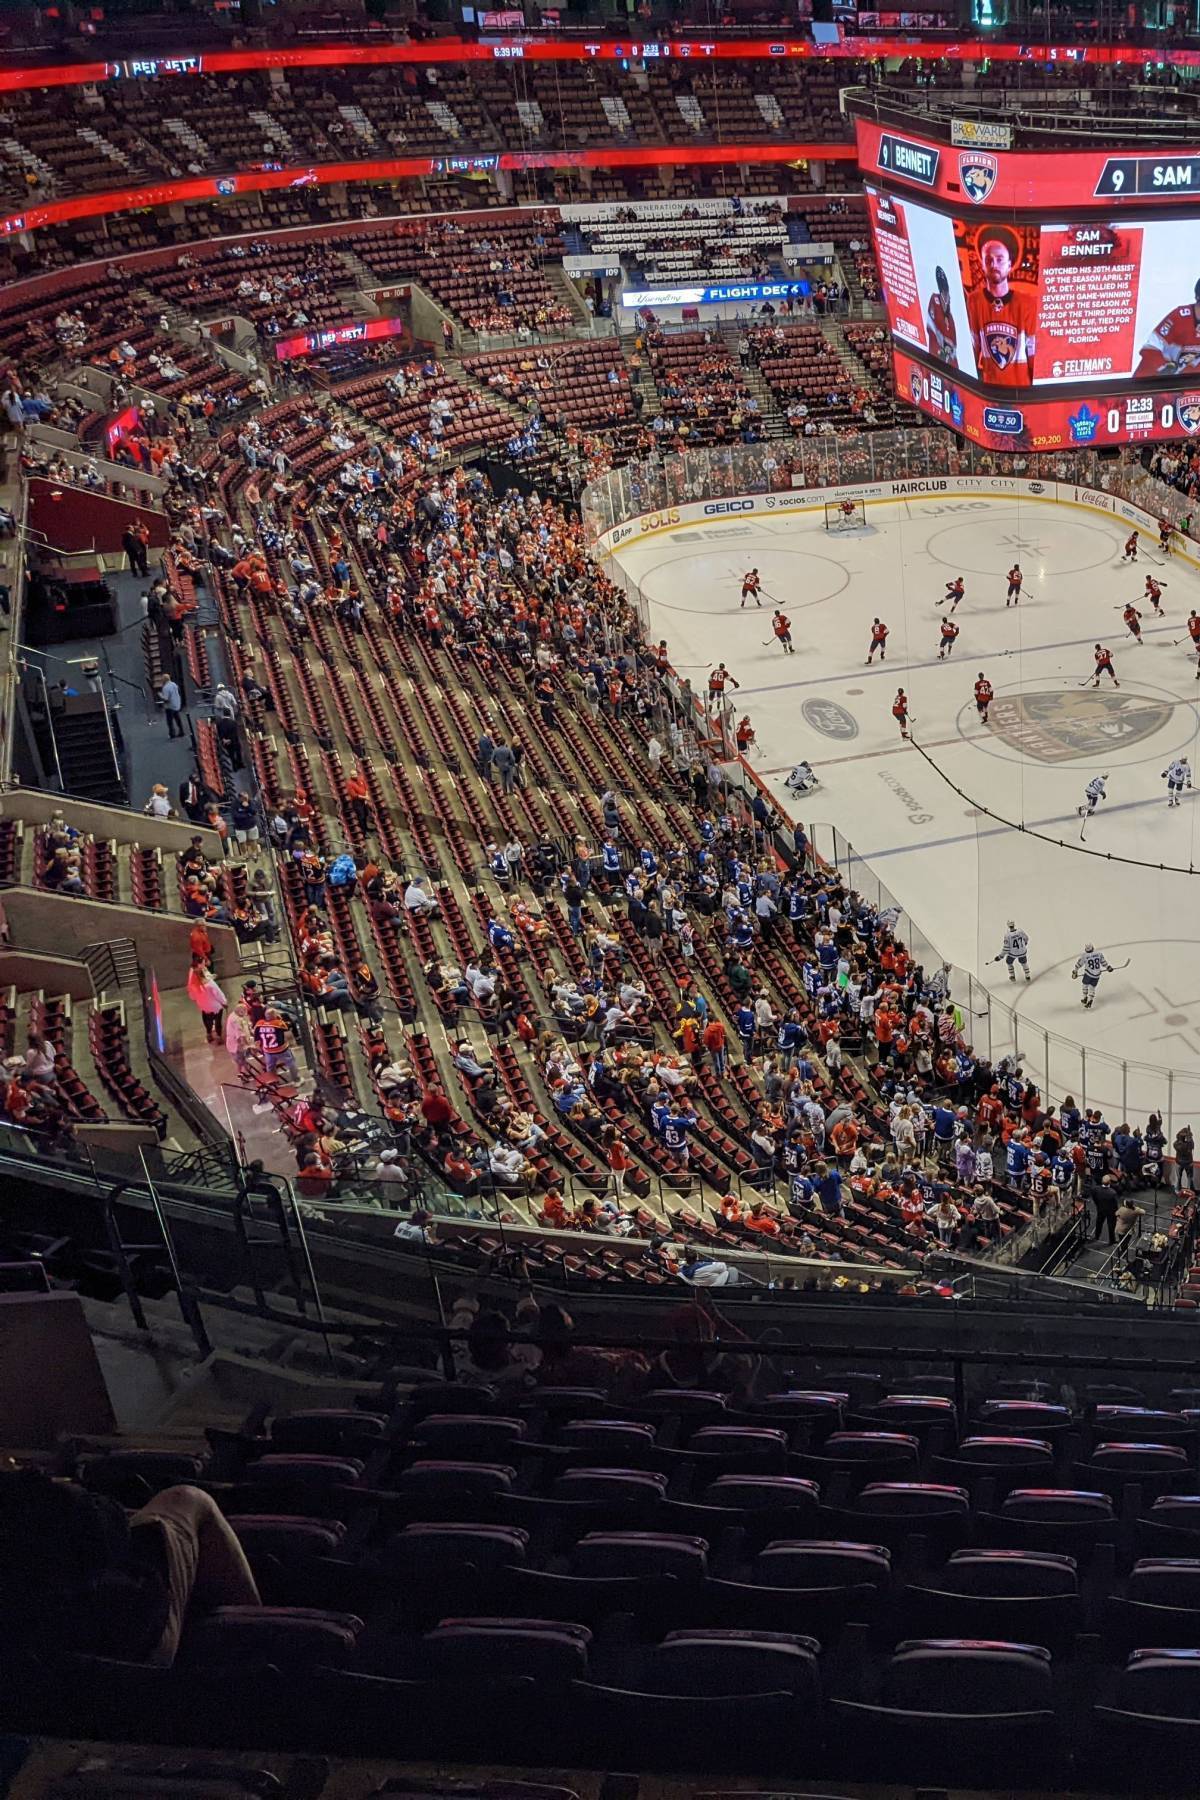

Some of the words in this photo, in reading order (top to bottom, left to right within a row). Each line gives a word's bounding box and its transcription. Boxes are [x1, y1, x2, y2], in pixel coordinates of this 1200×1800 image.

[512, 47, 524, 57] PM
[882, 144, 888, 165] 9
[896, 145, 932, 176] BENNETT
[962, 155, 992, 166] FLORIDA
[1112, 170, 1124, 192] 9
[1152, 166, 1192, 186] SAM
[633, 203, 684, 212] GENERATION
[1076, 230, 1100, 241] SAM
[1062, 244, 1114, 256] BENNETT
[606, 268, 619, 277] 109
[1043, 266, 1078, 275] NOTCHED
[1080, 266, 1091, 274] HIS
[1092, 265, 1110, 273] 20TH
[1112, 264, 1135, 272] ASSIST
[710, 286, 758, 298] FLIGHT
[1042, 294, 1074, 302] SEVENTH
[1076, 291, 1132, 300] GAME-WINNING
[1092, 300, 1119, 308] SEASON
[1065, 358, 1112, 372] FELTMAN'S
[924, 378, 928, 400] 0
[944, 390, 950, 413] 0
[988, 414, 997, 423] 50
[1006, 417, 1016, 425] 50
[1108, 410, 1119, 433] 0
[1126, 398, 1153, 412] 12:33
[1162, 405, 1173, 428] 0
[1033, 436, 1061, 446] $29,200
[892, 480, 948, 495] HAIRCLUB
[956, 479, 982, 487] CITY
[990, 479, 1016, 488] CITY
[779, 495, 825, 506] socios.com
[704, 500, 754, 515] GEICO
[922, 501, 992, 516] UKG
[640, 509, 680, 532] SOLIS
[712, 673, 724, 682] 40
[980, 686, 989, 694] 42
[993, 702, 1058, 756] PANTHERS
[1012, 937, 1024, 949] 47
[1088, 958, 1100, 970] 88
[260, 1033, 278, 1048] 12
[983, 1107, 990, 1117] 11
[665, 1130, 678, 1143] 43
[785, 1150, 797, 1167] 34
[1052, 1167, 1064, 1181] 14
[1031, 1178, 1043, 1192] 16
